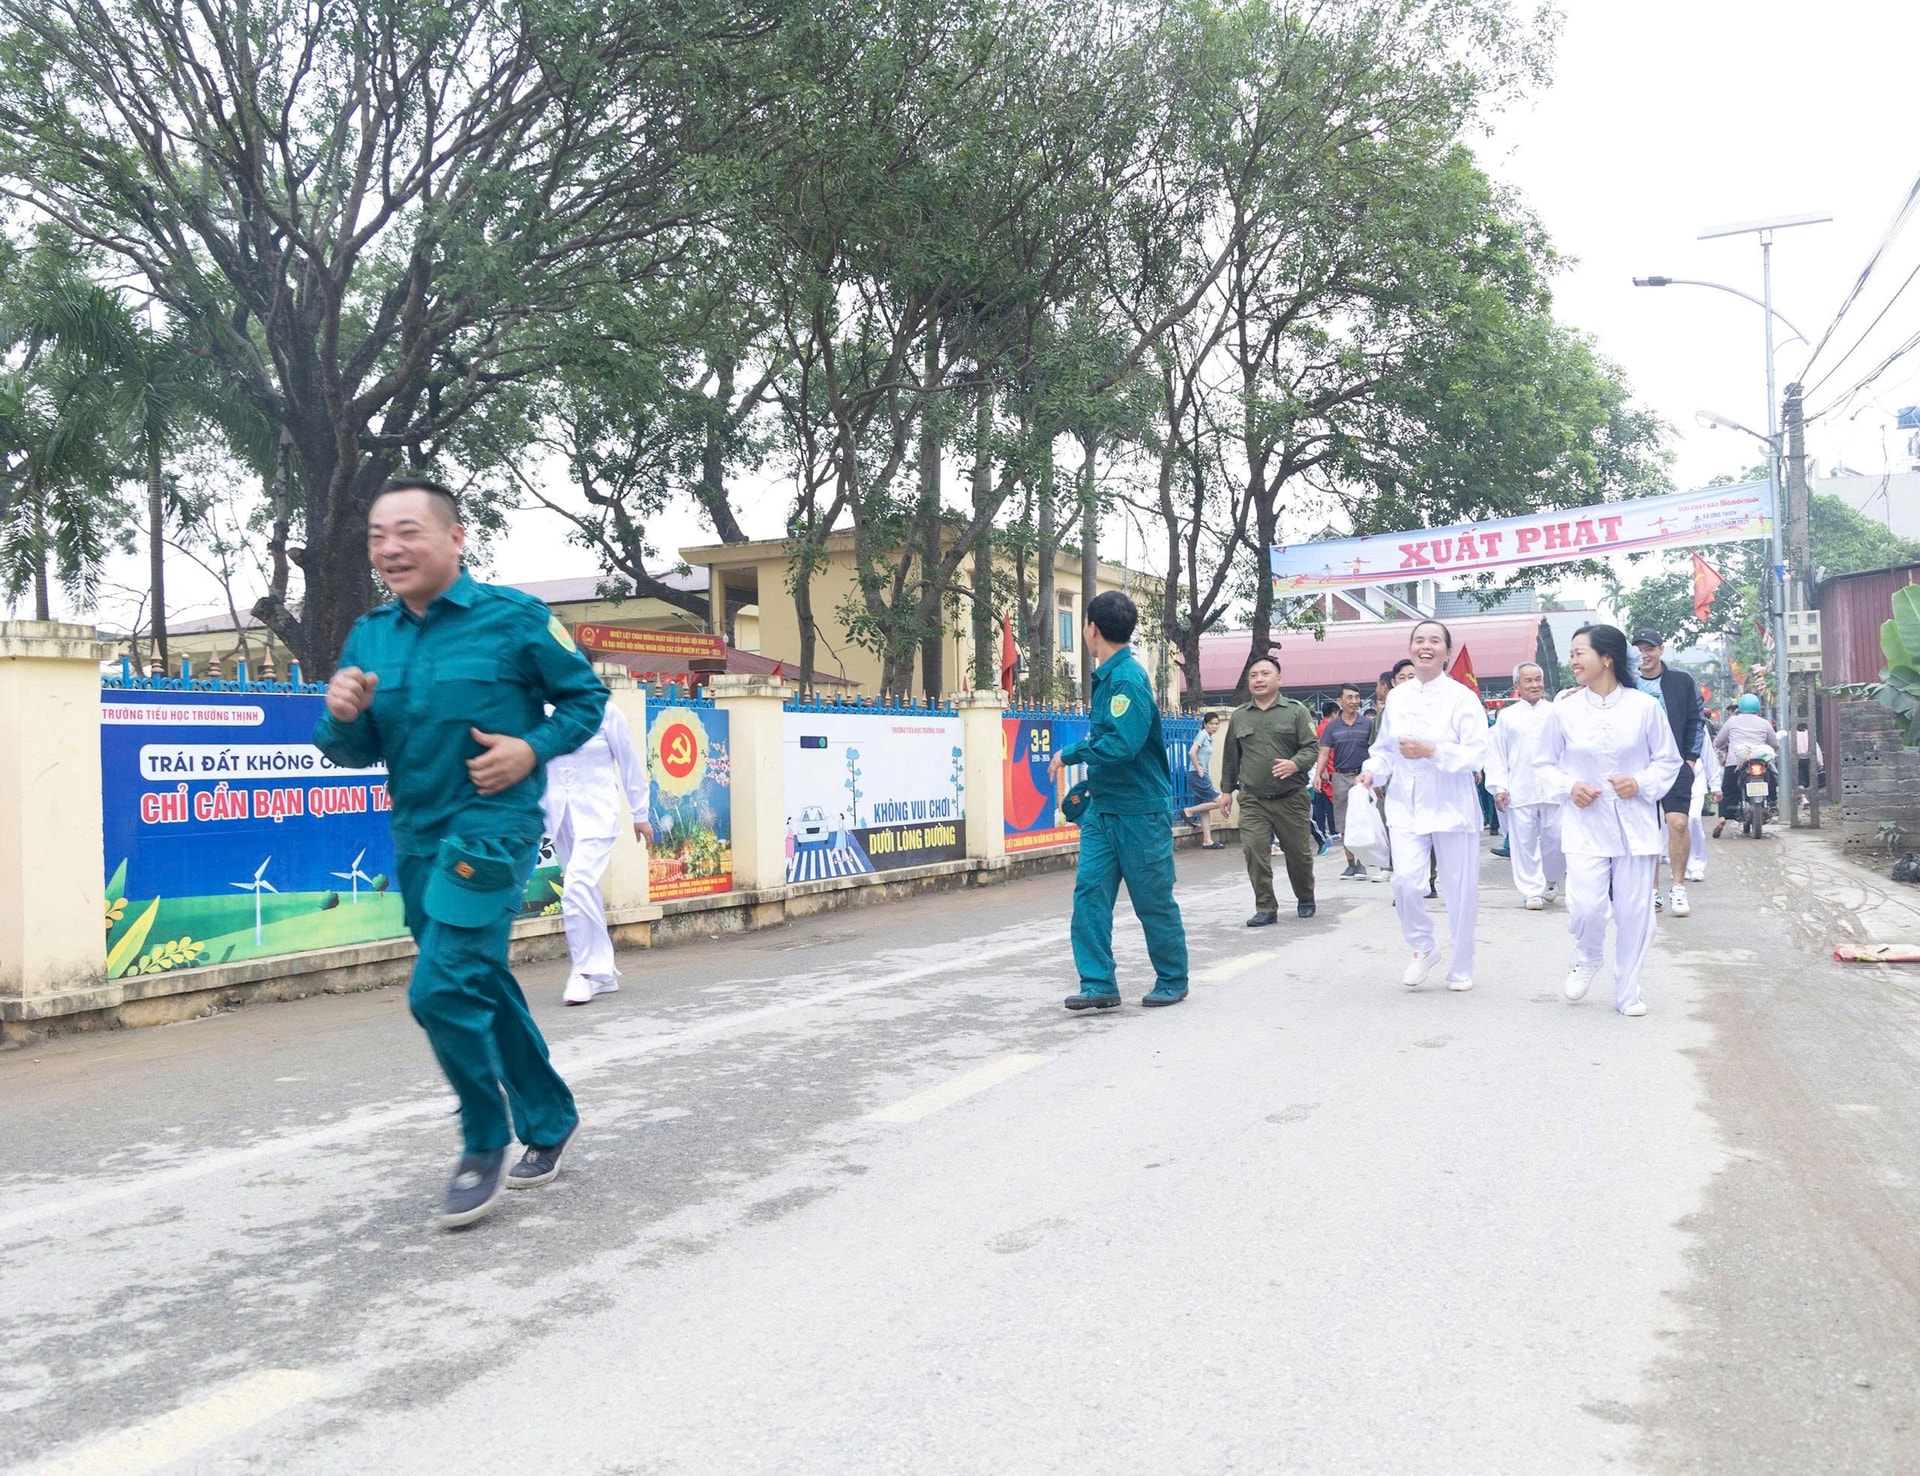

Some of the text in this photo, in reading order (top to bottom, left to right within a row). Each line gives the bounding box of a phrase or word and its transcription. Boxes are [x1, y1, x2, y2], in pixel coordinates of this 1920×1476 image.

[1399, 515, 1623, 568] XUẤT PHÁT
[103, 705, 258, 723] TRƯỜNG TIỂU HỌC TRƯỜNG THỊNH
[1030, 728, 1050, 753] 3-2
[148, 751, 194, 772] TRÁI
[201, 748, 240, 771] ĐẤT
[247, 751, 314, 770] KHÔNG
[142, 784, 187, 822] CHỈ
[195, 783, 248, 820] CẦN
[254, 788, 303, 822] BẠN
[309, 787, 366, 816] QUAN
[874, 797, 950, 823] KHÔNG VUI CHƠI
[869, 822, 956, 855] DƯỚI LÒNG ĐƯỜNG
